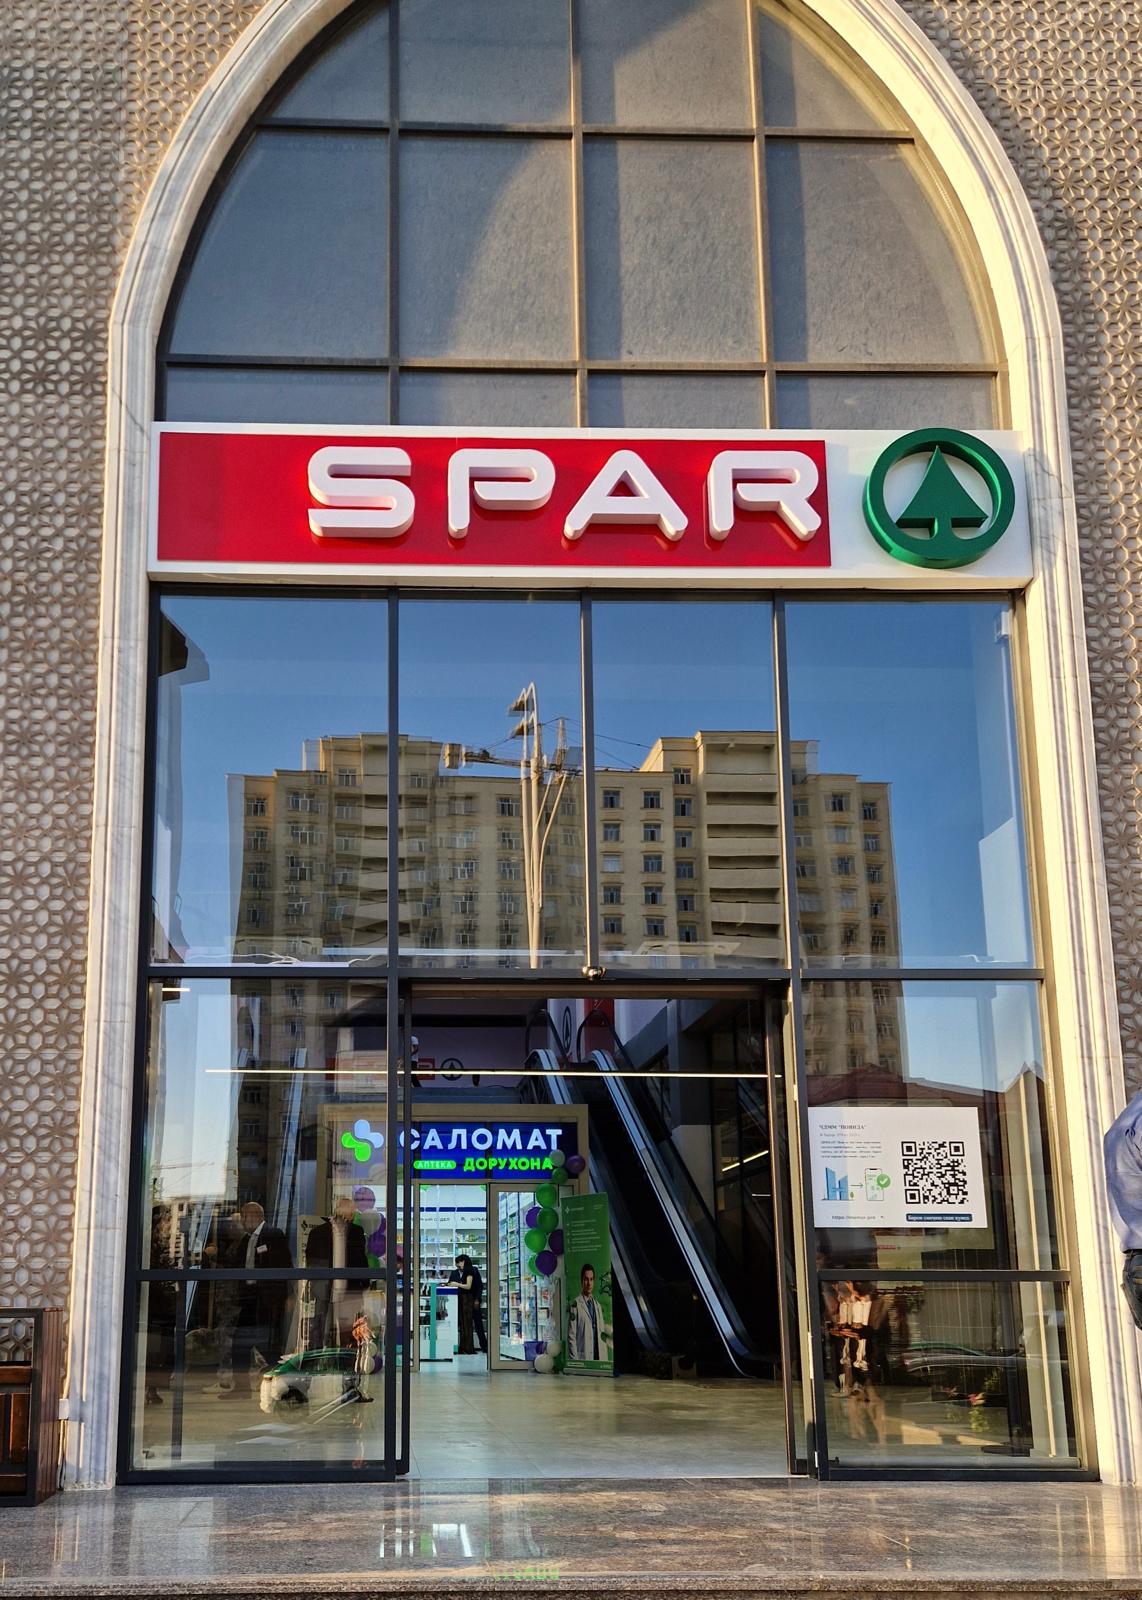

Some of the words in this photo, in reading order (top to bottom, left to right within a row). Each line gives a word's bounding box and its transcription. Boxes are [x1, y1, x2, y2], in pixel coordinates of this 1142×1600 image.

[307, 445, 822, 542] SPAR
[399, 1127, 563, 1150] САЛОМАТ
[416, 1160, 453, 1169] АПТЕКА
[463, 1157, 554, 1172] ДОРУХОНА
